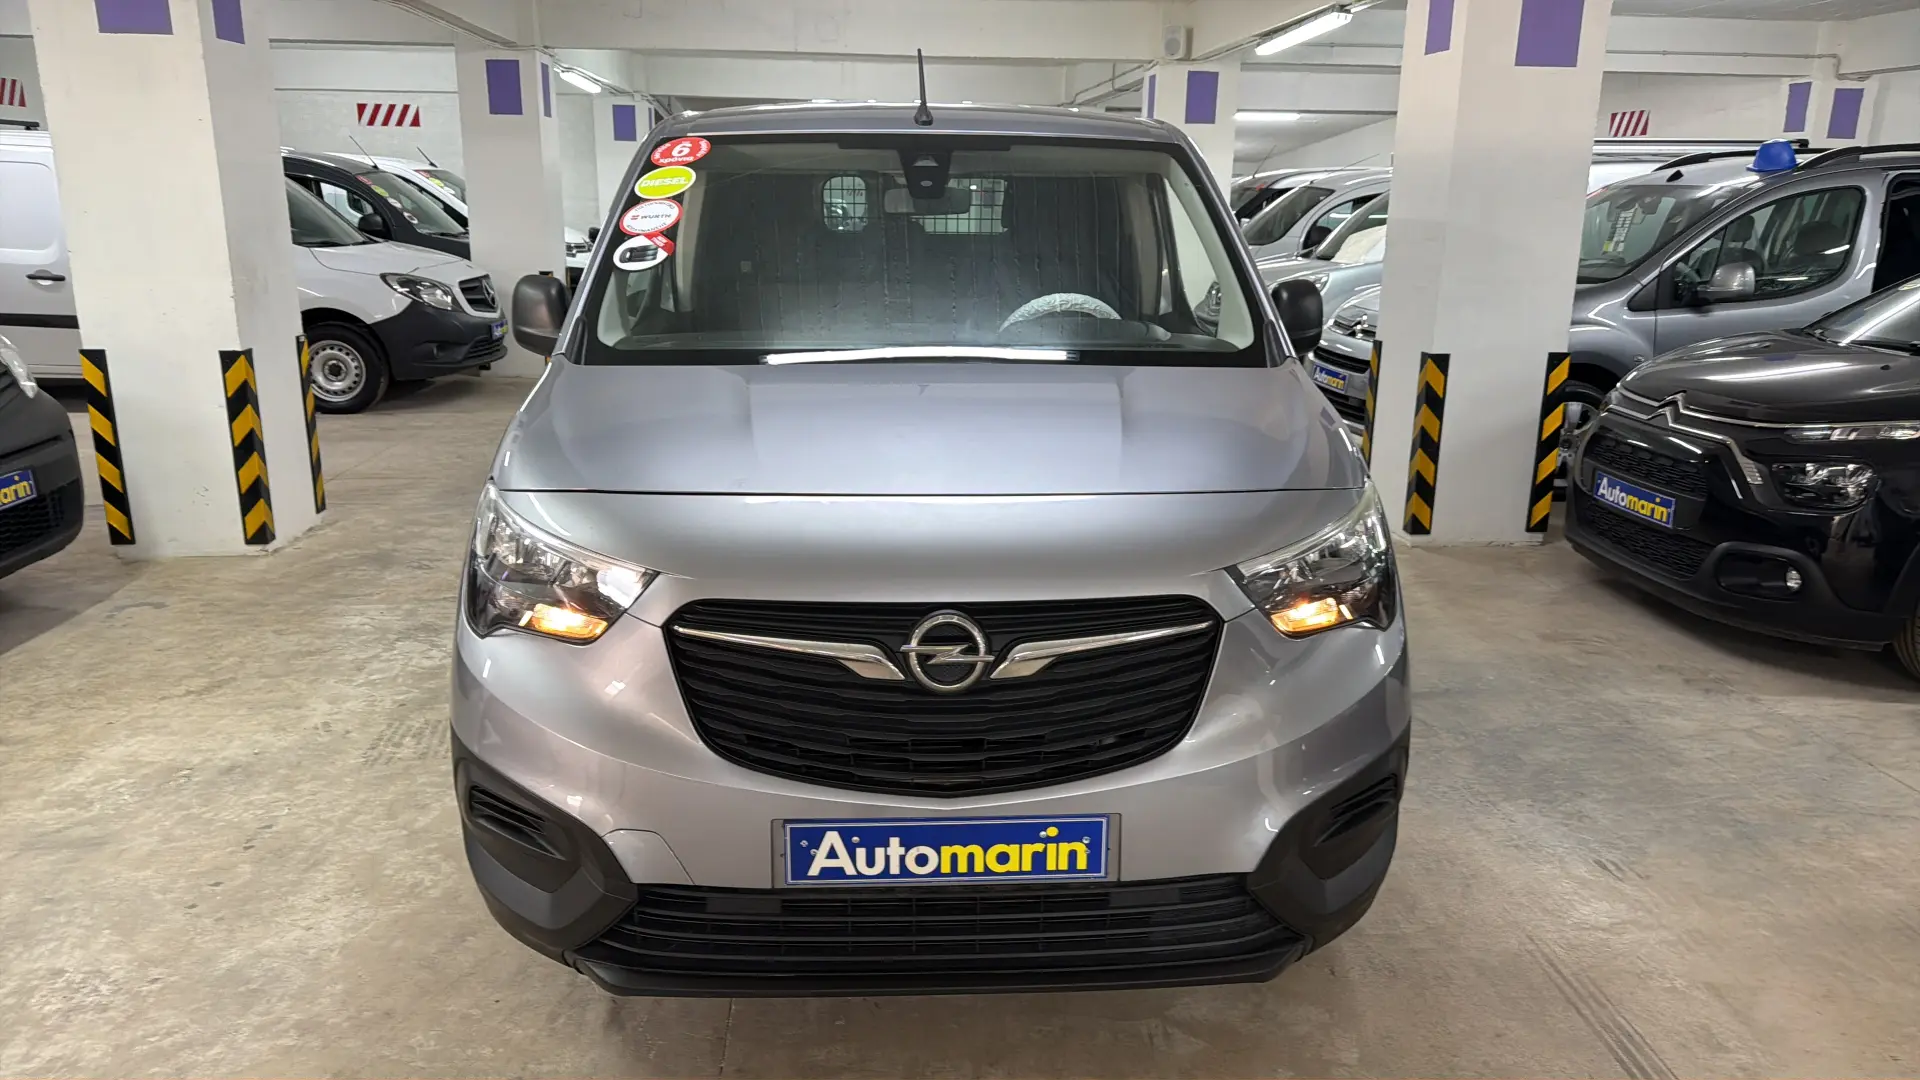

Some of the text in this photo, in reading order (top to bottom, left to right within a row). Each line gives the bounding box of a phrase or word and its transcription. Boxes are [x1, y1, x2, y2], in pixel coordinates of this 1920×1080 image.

[671, 143, 692, 157] 6
[641, 177, 688, 187] DIESEL
[0, 475, 31, 505] arin
[1597, 477, 1668, 522] Automarin
[807, 827, 1088, 876] Automarin
